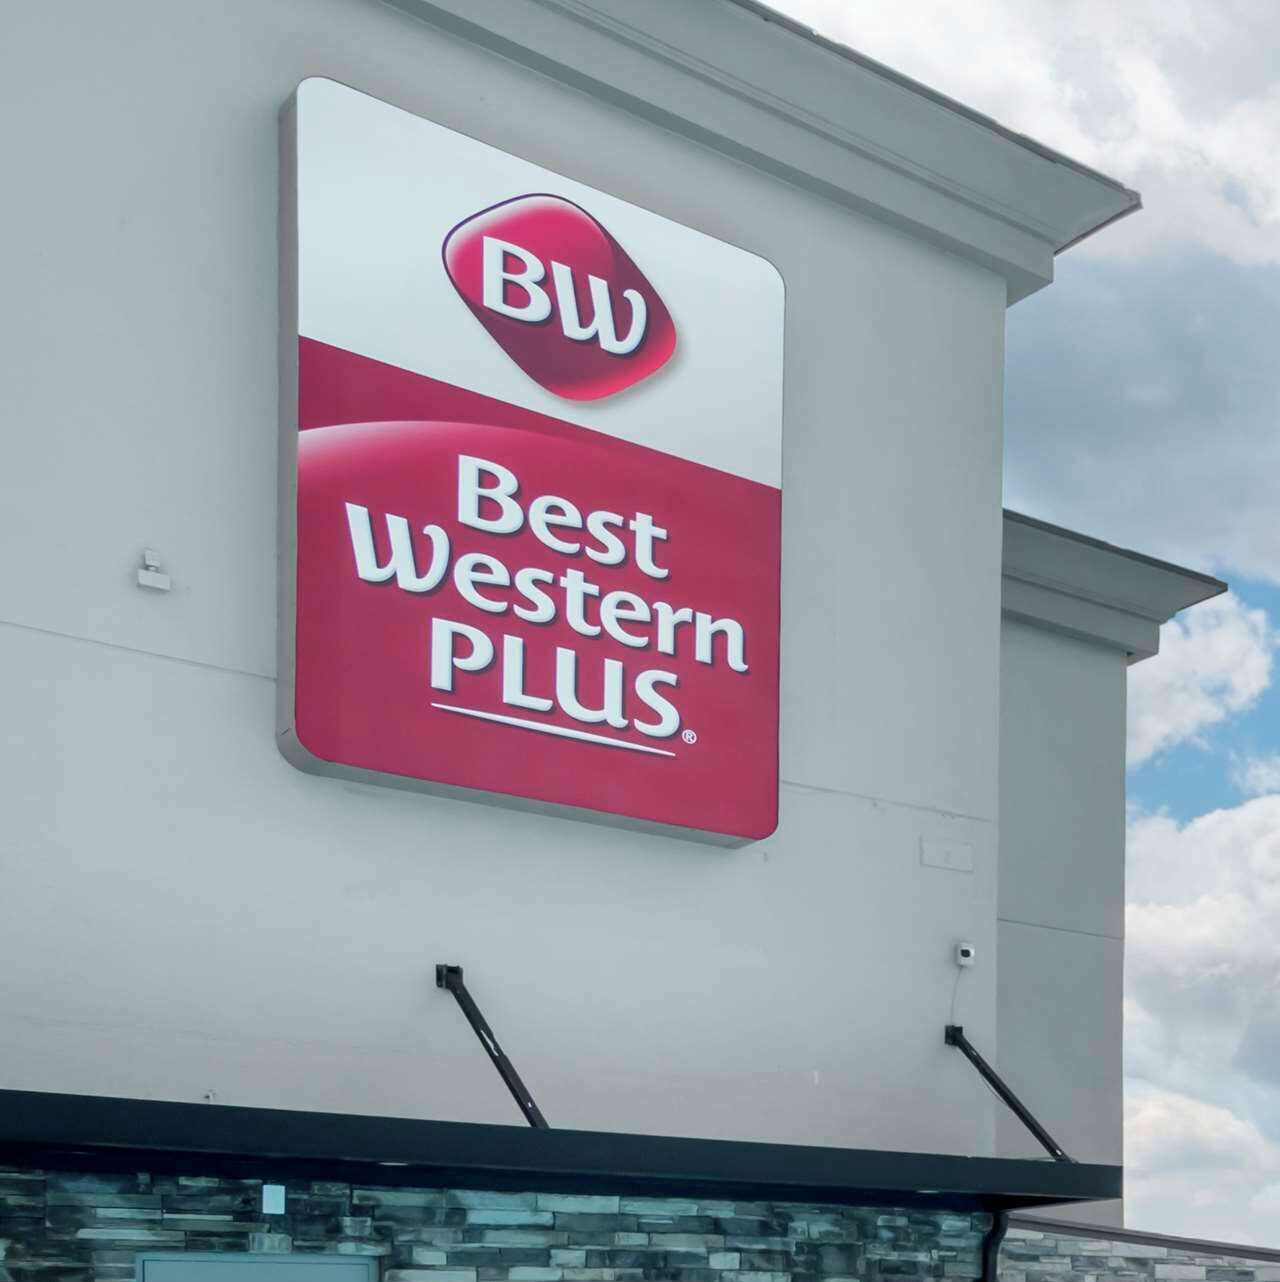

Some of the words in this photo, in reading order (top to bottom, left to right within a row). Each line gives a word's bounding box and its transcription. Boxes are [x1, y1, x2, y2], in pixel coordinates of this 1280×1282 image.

[483, 236, 648, 355] BW
[458, 454, 670, 579] Best
[345, 502, 749, 672] Western
[431, 617, 682, 738] PLUS
